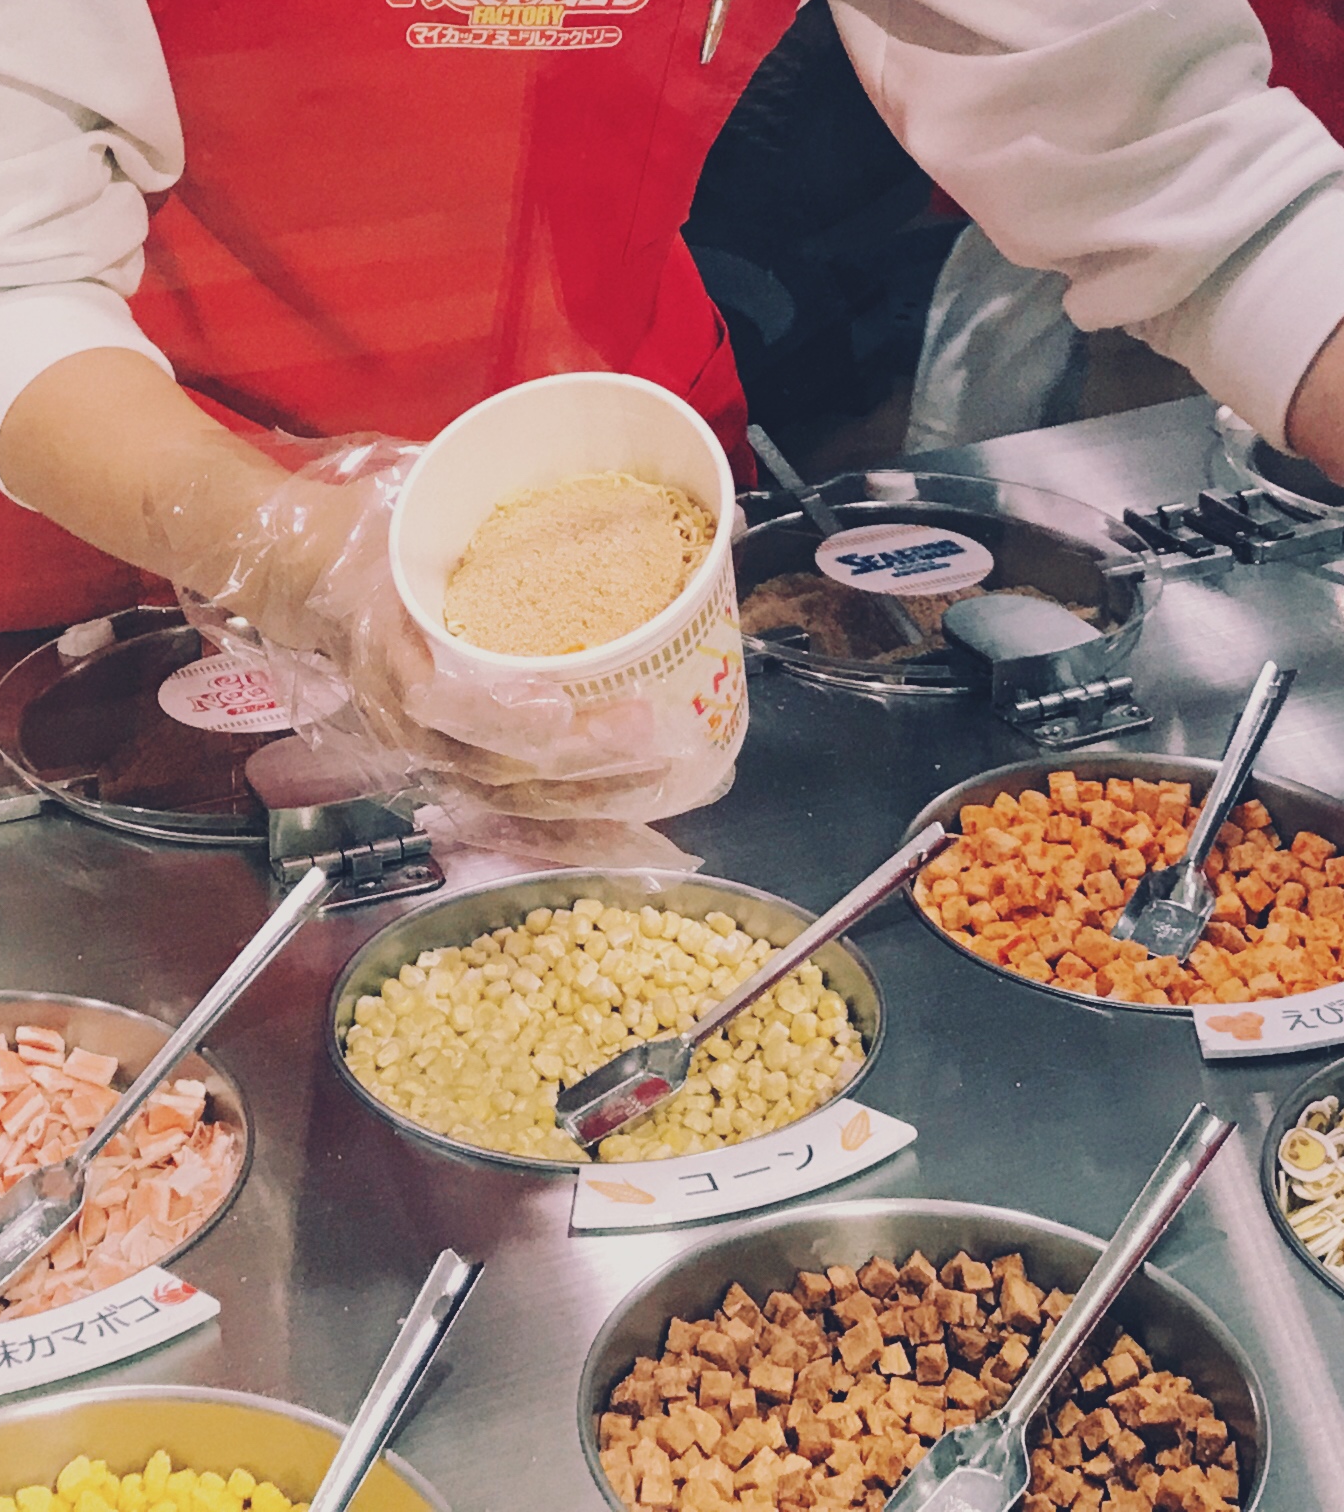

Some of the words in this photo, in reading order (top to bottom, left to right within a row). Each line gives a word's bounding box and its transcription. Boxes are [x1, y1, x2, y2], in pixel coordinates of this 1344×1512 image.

[472, 4, 565, 26] FACTORY
[678, 1144, 814, 1196] コーン
